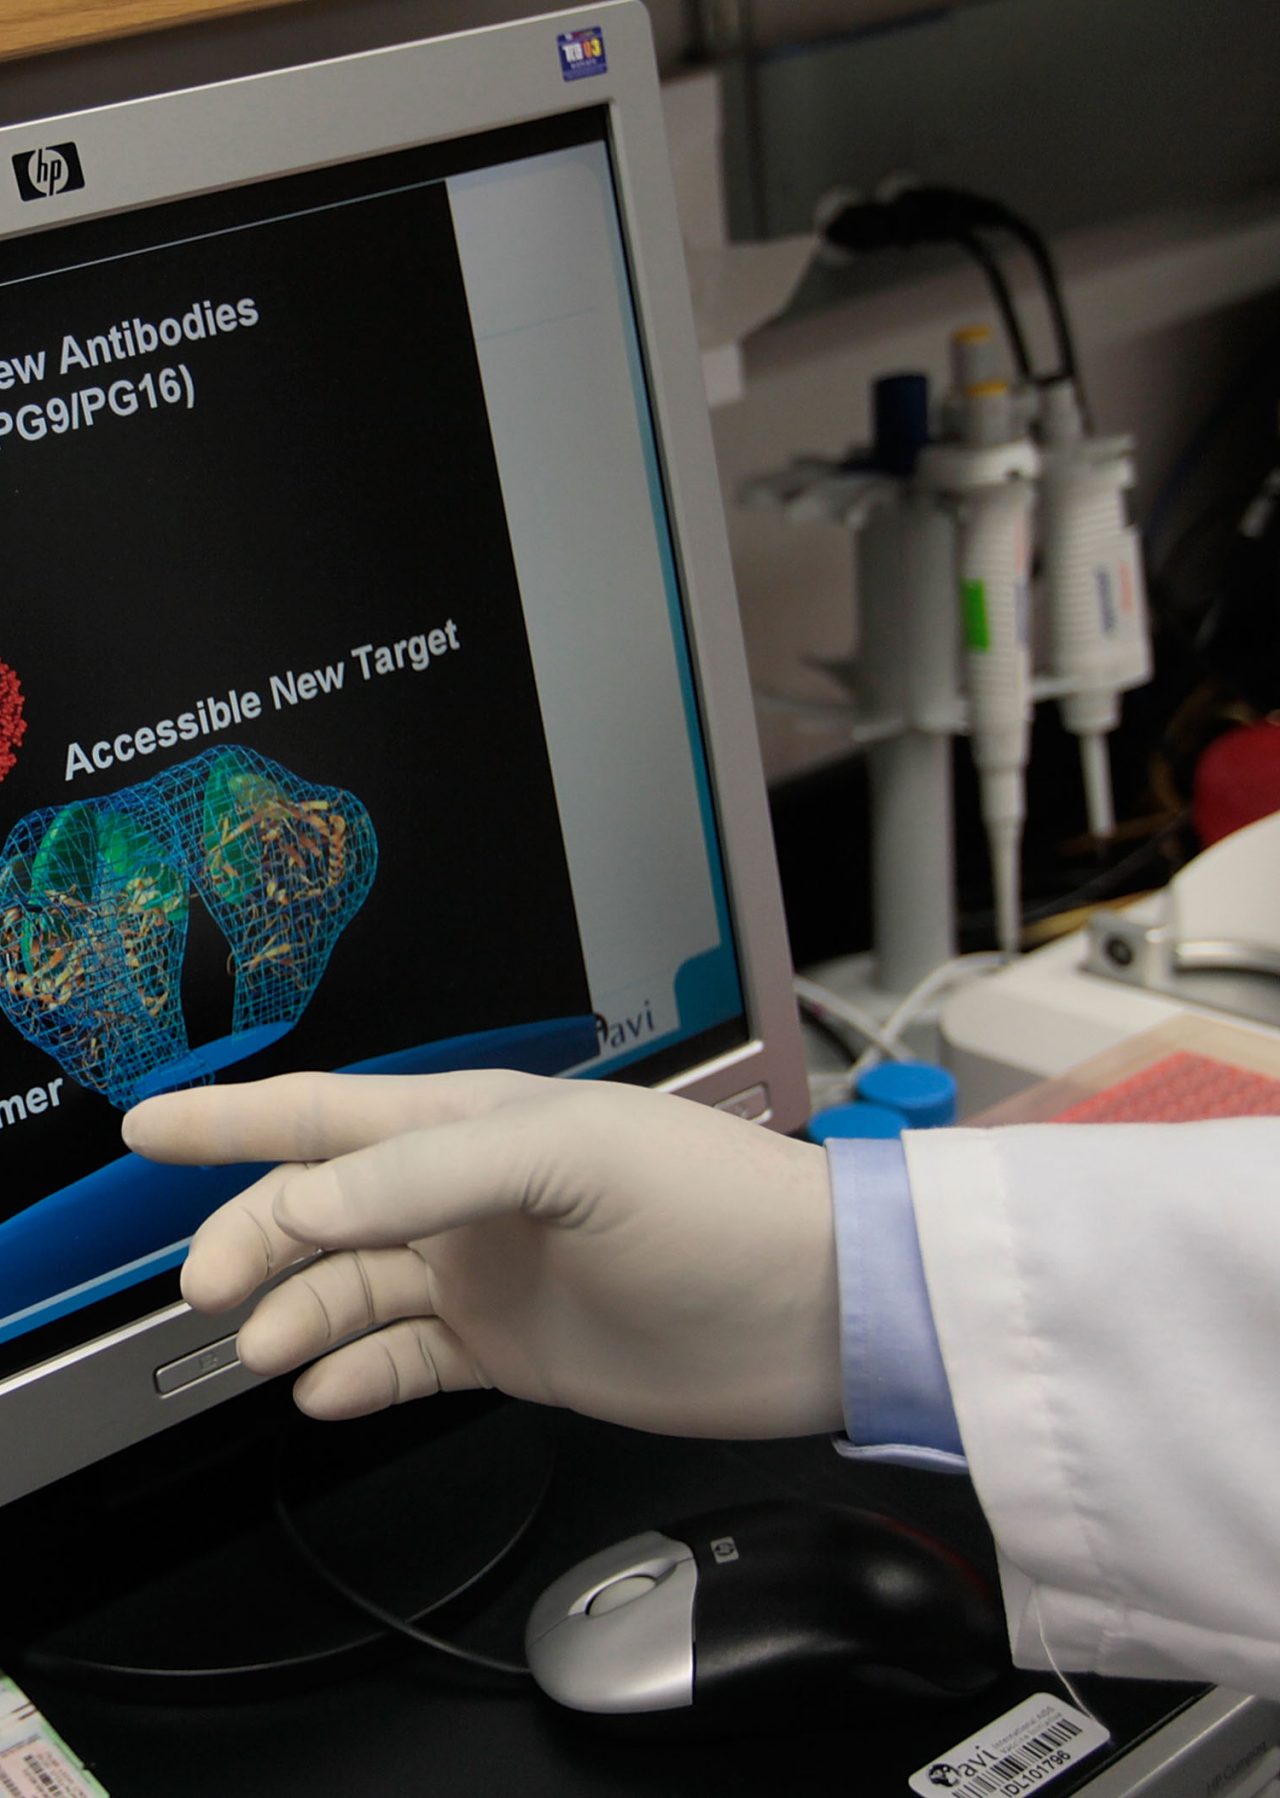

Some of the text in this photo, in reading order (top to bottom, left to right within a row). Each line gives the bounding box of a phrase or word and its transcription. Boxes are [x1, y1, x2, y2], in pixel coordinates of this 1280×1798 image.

[59, 297, 260, 375] Antibodies
[64, 618, 461, 782] Accessible New Target
[999, 1749, 1071, 1798] IDL101796
